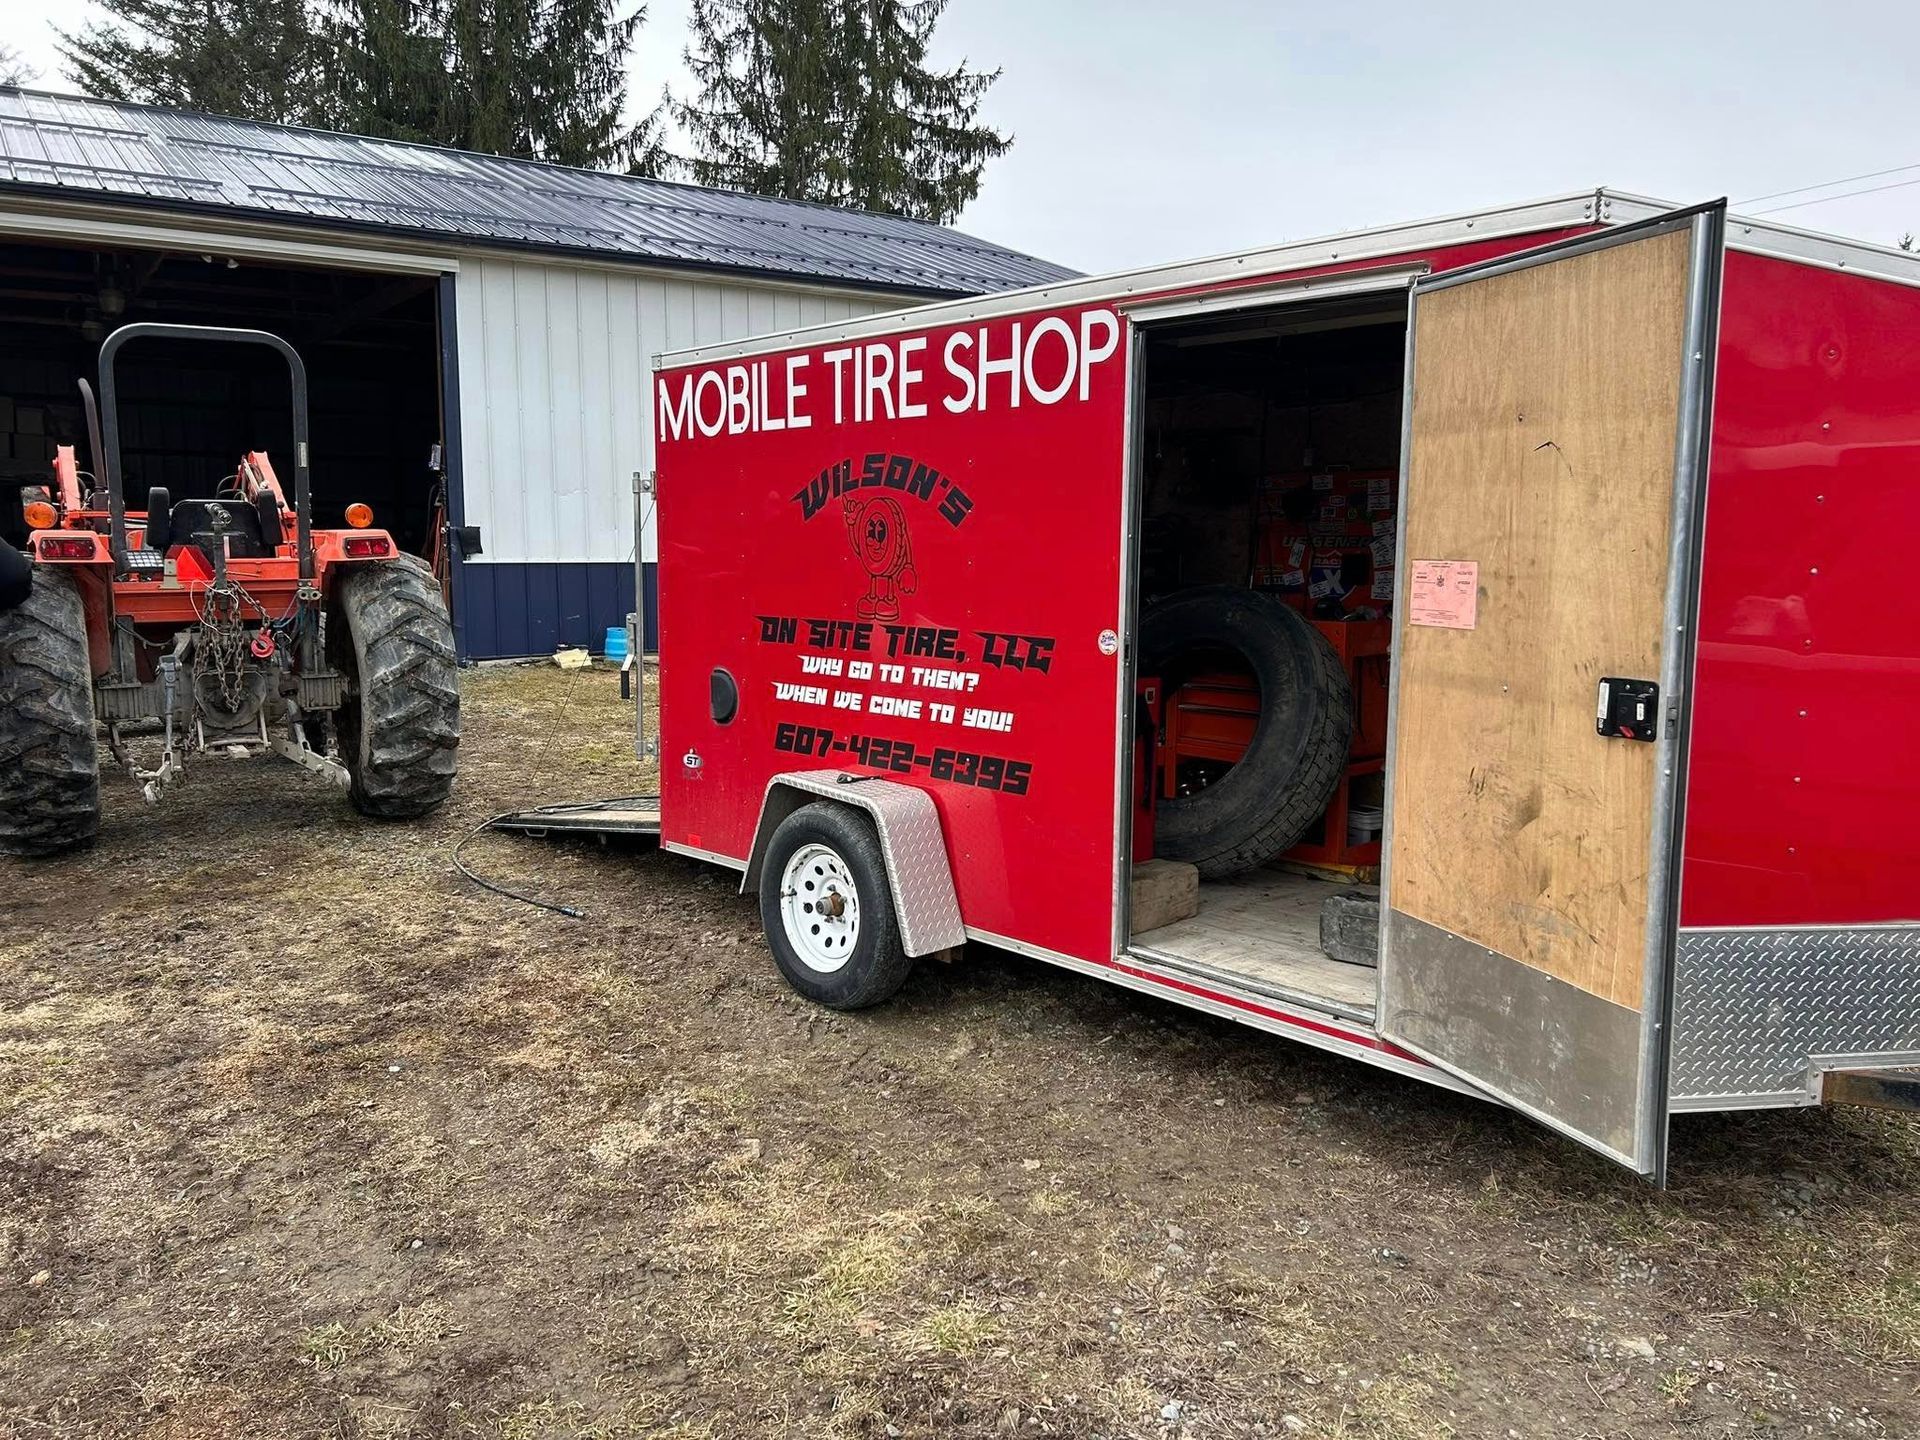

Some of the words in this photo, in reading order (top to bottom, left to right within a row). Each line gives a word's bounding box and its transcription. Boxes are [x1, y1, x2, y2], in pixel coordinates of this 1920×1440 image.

[658, 354, 812, 442] MOBILE
[823, 337, 928, 424] TIRE
[942, 309, 1120, 414] SHOP
[790, 453, 974, 528] WILSON'S
[1313, 536, 1370, 547] GENER
[754, 616, 798, 644] ON
[801, 618, 874, 651] SITE
[879, 624, 966, 663] TIRE,
[970, 630, 1056, 675] LLC
[797, 655, 843, 676] WHY
[848, 660, 874, 680] GO
[879, 663, 905, 684] TO
[911, 667, 980, 692] THEM?
[771, 681, 828, 706] WHEN
[833, 690, 863, 711] WE
[869, 695, 923, 719] COME
[929, 702, 956, 724] TO
[962, 708, 1014, 732] YOU!
[775, 722, 1033, 795] 607-422-6395
